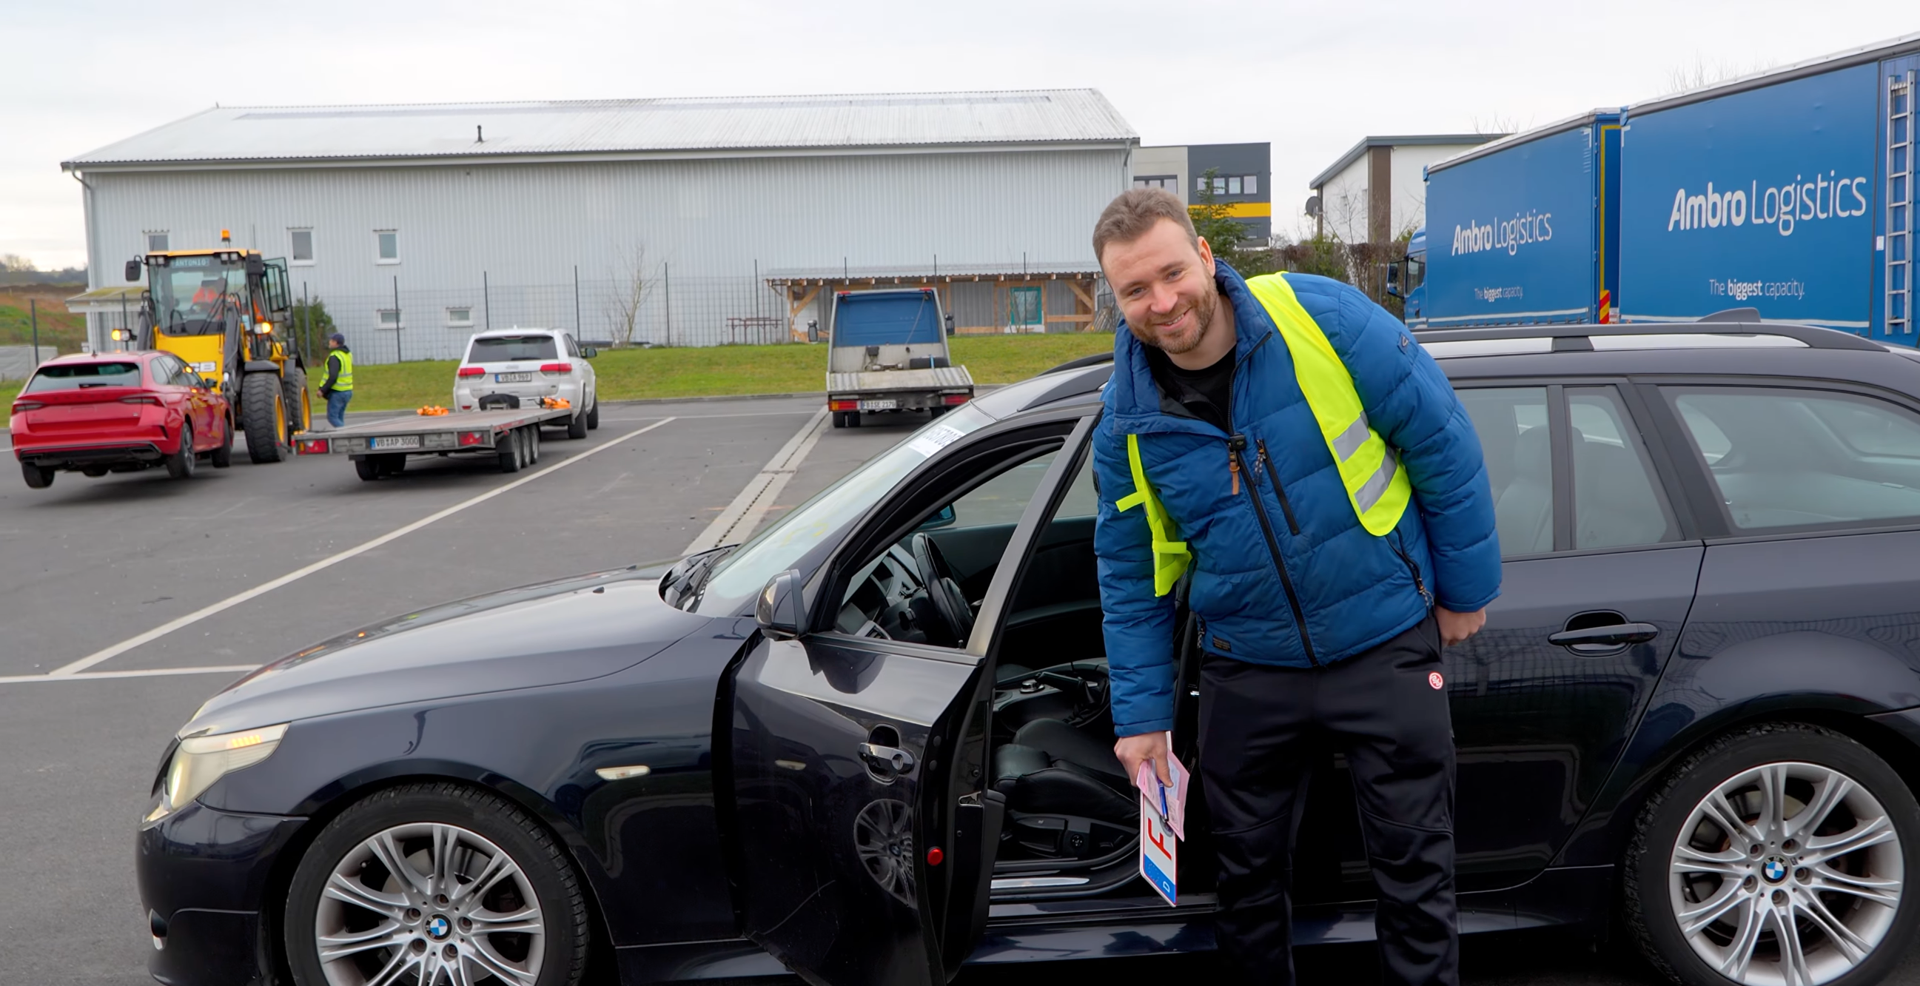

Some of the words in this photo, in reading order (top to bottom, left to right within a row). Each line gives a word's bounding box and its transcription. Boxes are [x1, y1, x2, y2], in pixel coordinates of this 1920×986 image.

[1668, 181, 1747, 232] Ambro
[1751, 169, 1867, 236] Logistics
[1452, 219, 1493, 256] Ambro
[1494, 208, 1552, 256] Logistics
[1474, 288, 1483, 300] The
[1483, 286, 1503, 302] biggest
[1709, 278, 1725, 296] The
[1727, 278, 1763, 301] biggest
[1765, 278, 1805, 300] capacity.
[400, 437, 419, 446] 3000
[1147, 817, 1172, 860] F
[1162, 881, 1170, 893] D
